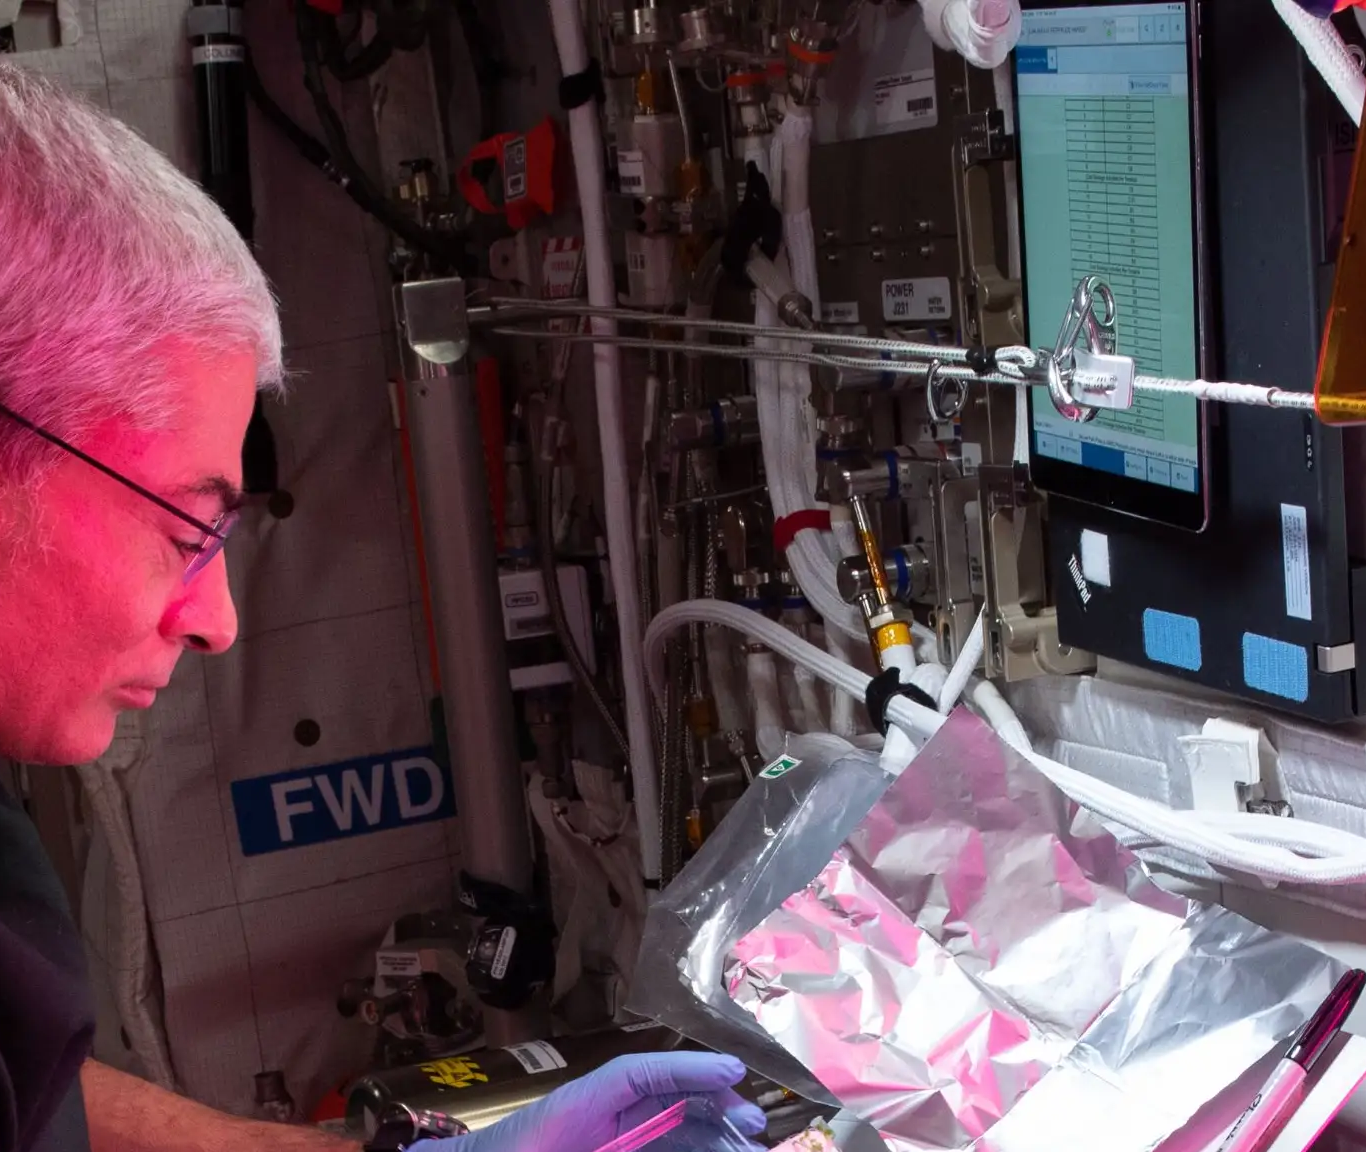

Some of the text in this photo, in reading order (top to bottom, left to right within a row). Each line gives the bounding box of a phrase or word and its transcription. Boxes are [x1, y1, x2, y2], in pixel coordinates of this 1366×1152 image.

[885, 282, 914, 298] POWER
[893, 301, 909, 316] J231
[1068, 553, 1092, 604] ThinkPad
[270, 756, 445, 843] FWD
